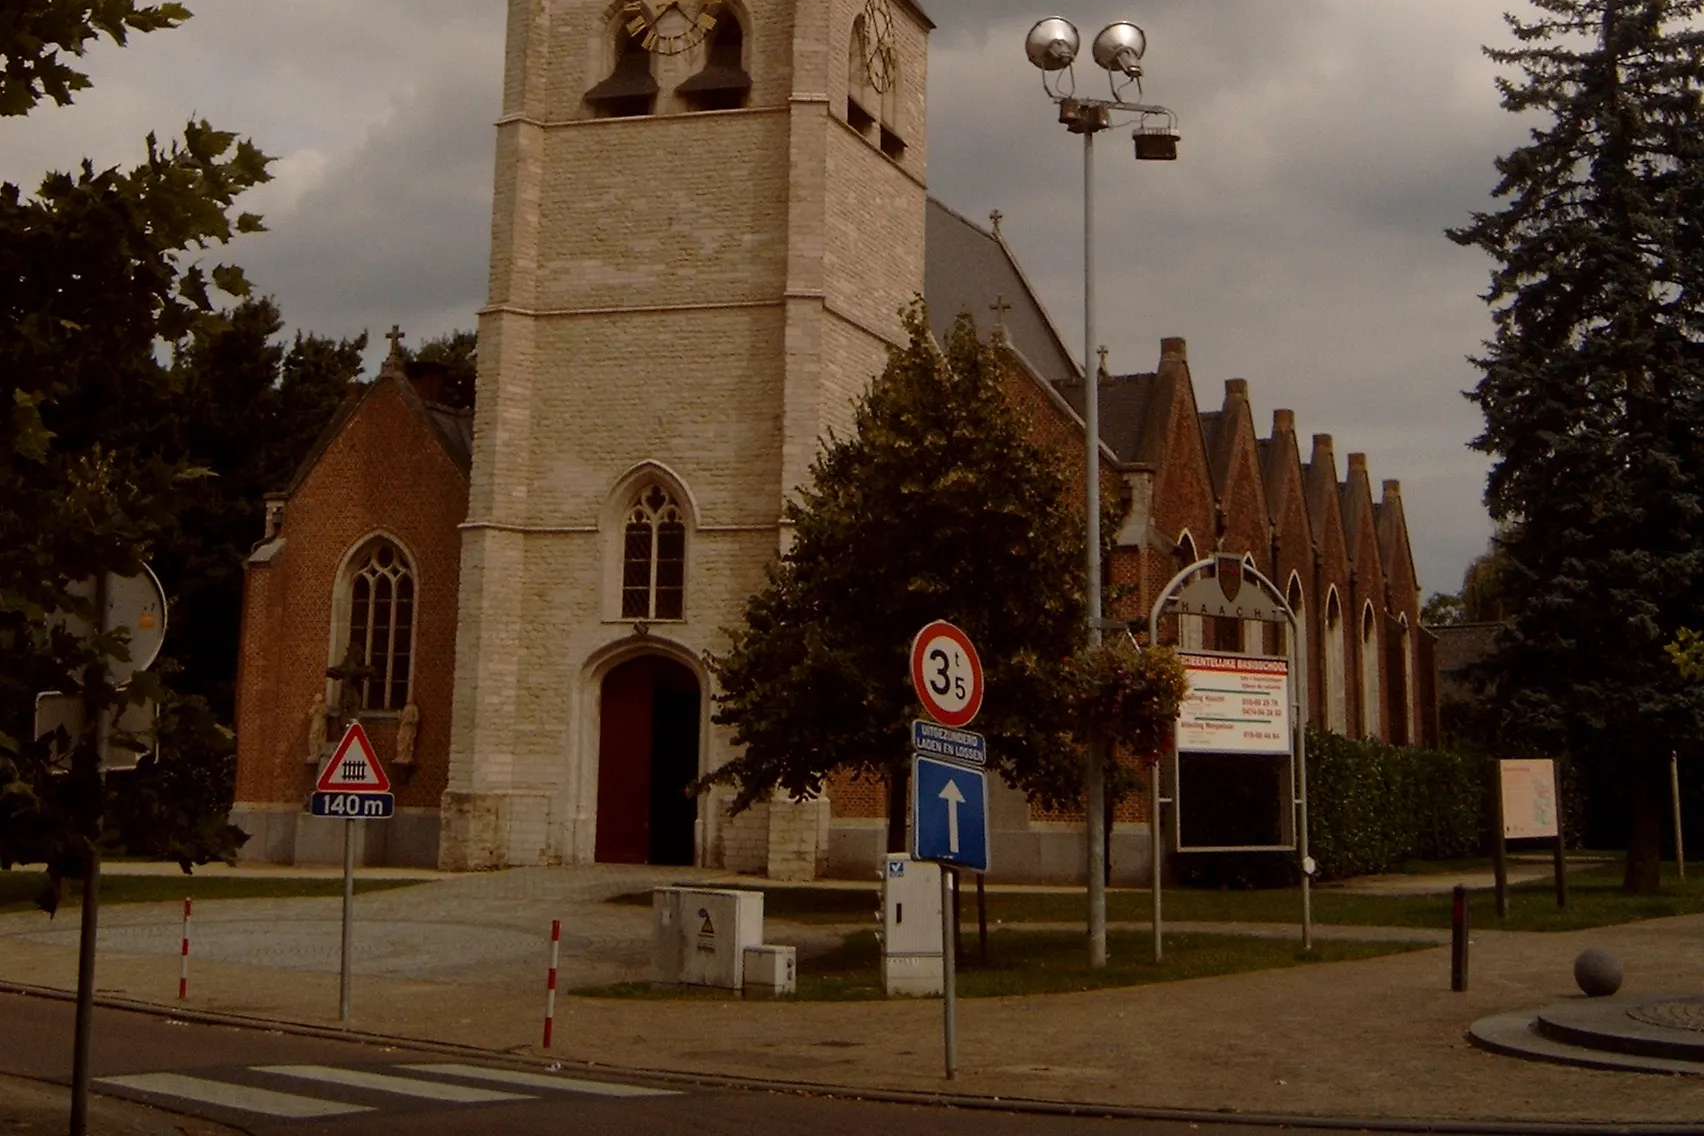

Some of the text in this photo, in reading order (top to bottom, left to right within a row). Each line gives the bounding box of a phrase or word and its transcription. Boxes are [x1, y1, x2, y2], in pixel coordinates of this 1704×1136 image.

[1182, 602, 1277, 620] HAACHT
[930, 649, 950, 695] 3
[955, 676, 966, 700] 5
[921, 724, 978, 747] UITGEZONDERD
[917, 737, 983, 762] LADEN EN LOSSEN
[323, 794, 384, 815] 140 m
